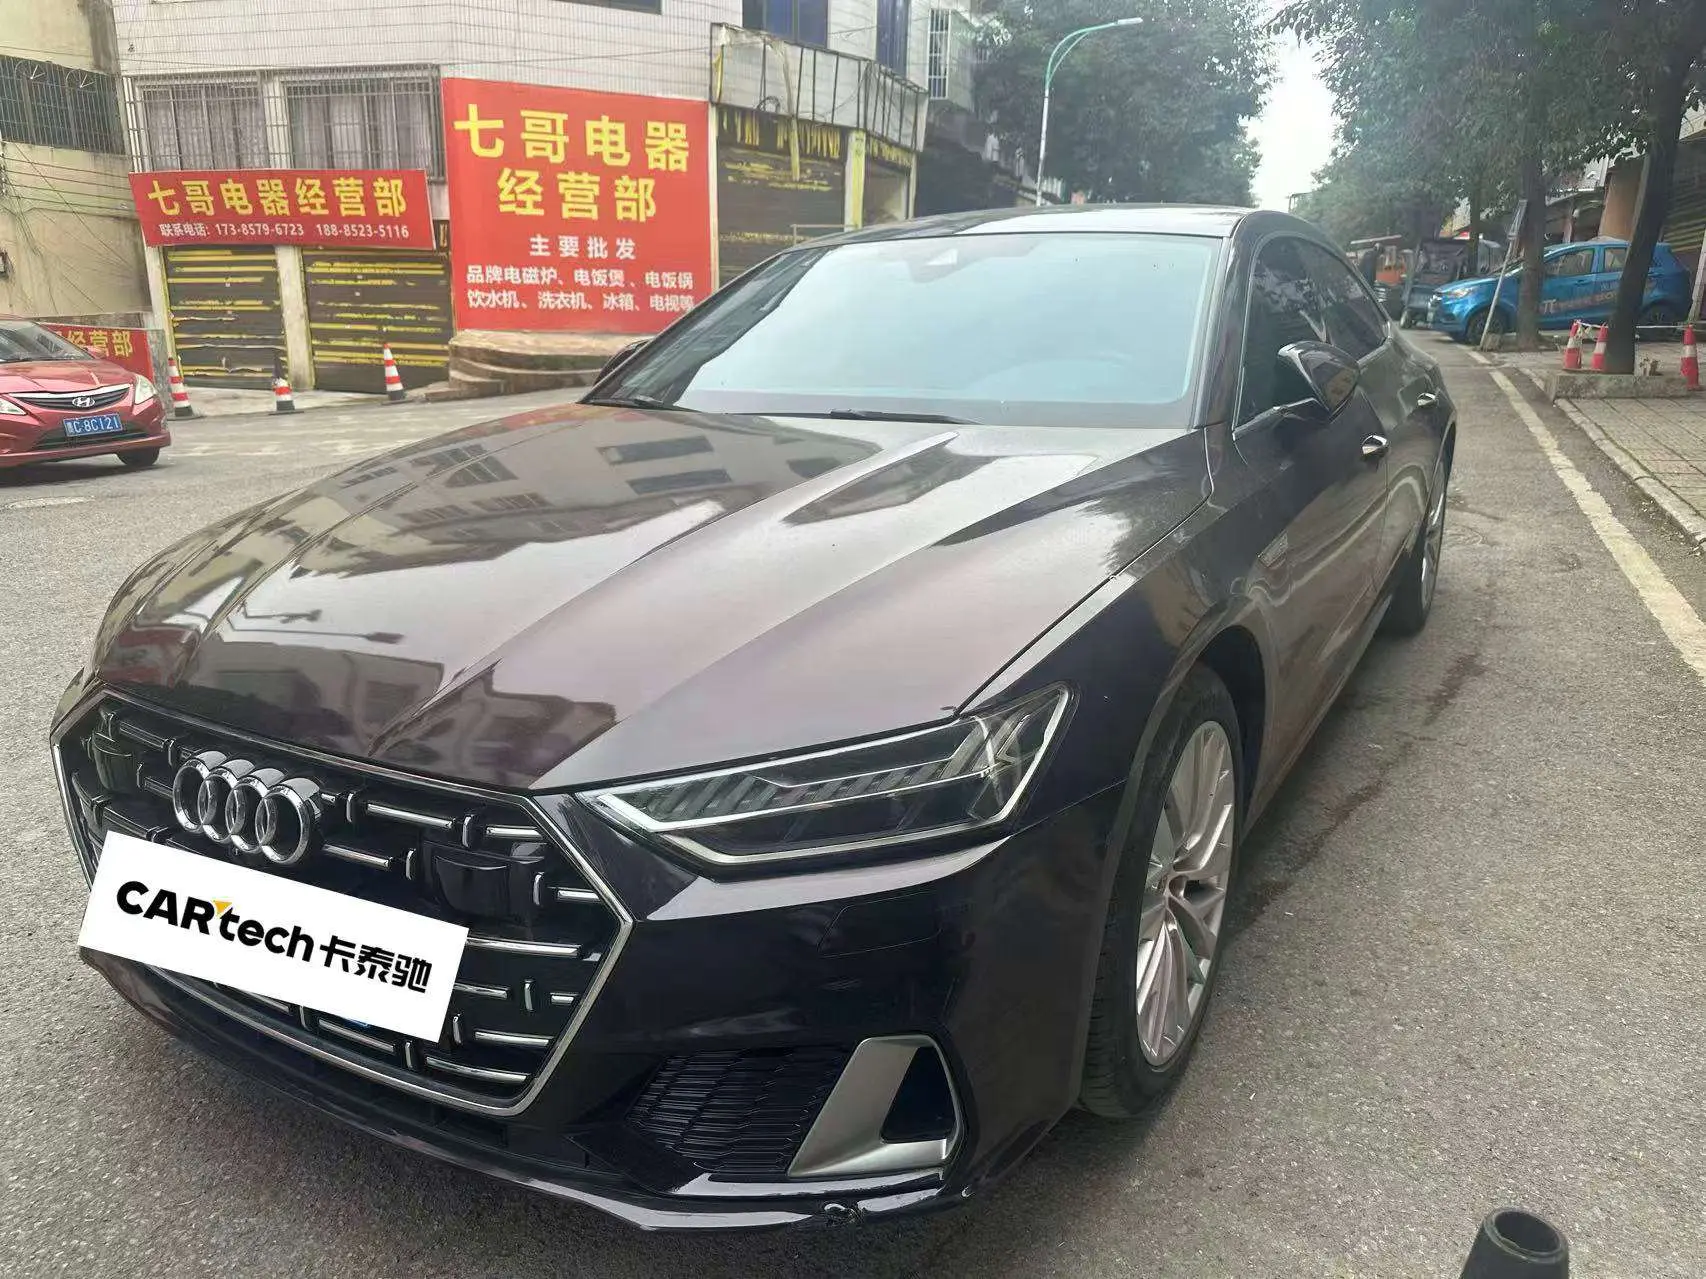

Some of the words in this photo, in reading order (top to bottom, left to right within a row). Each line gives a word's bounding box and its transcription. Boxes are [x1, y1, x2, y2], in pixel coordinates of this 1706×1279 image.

[453, 103, 690, 173] 七哥电器
[148, 177, 407, 218] 七哥电器经营部
[497, 167, 656, 223] 经营部
[215, 223, 304, 236] 173-8579-6723
[316, 223, 409, 238] 188-8523-5116
[529, 234, 637, 260] 主要批发
[57, 330, 133, 357] 经营部
